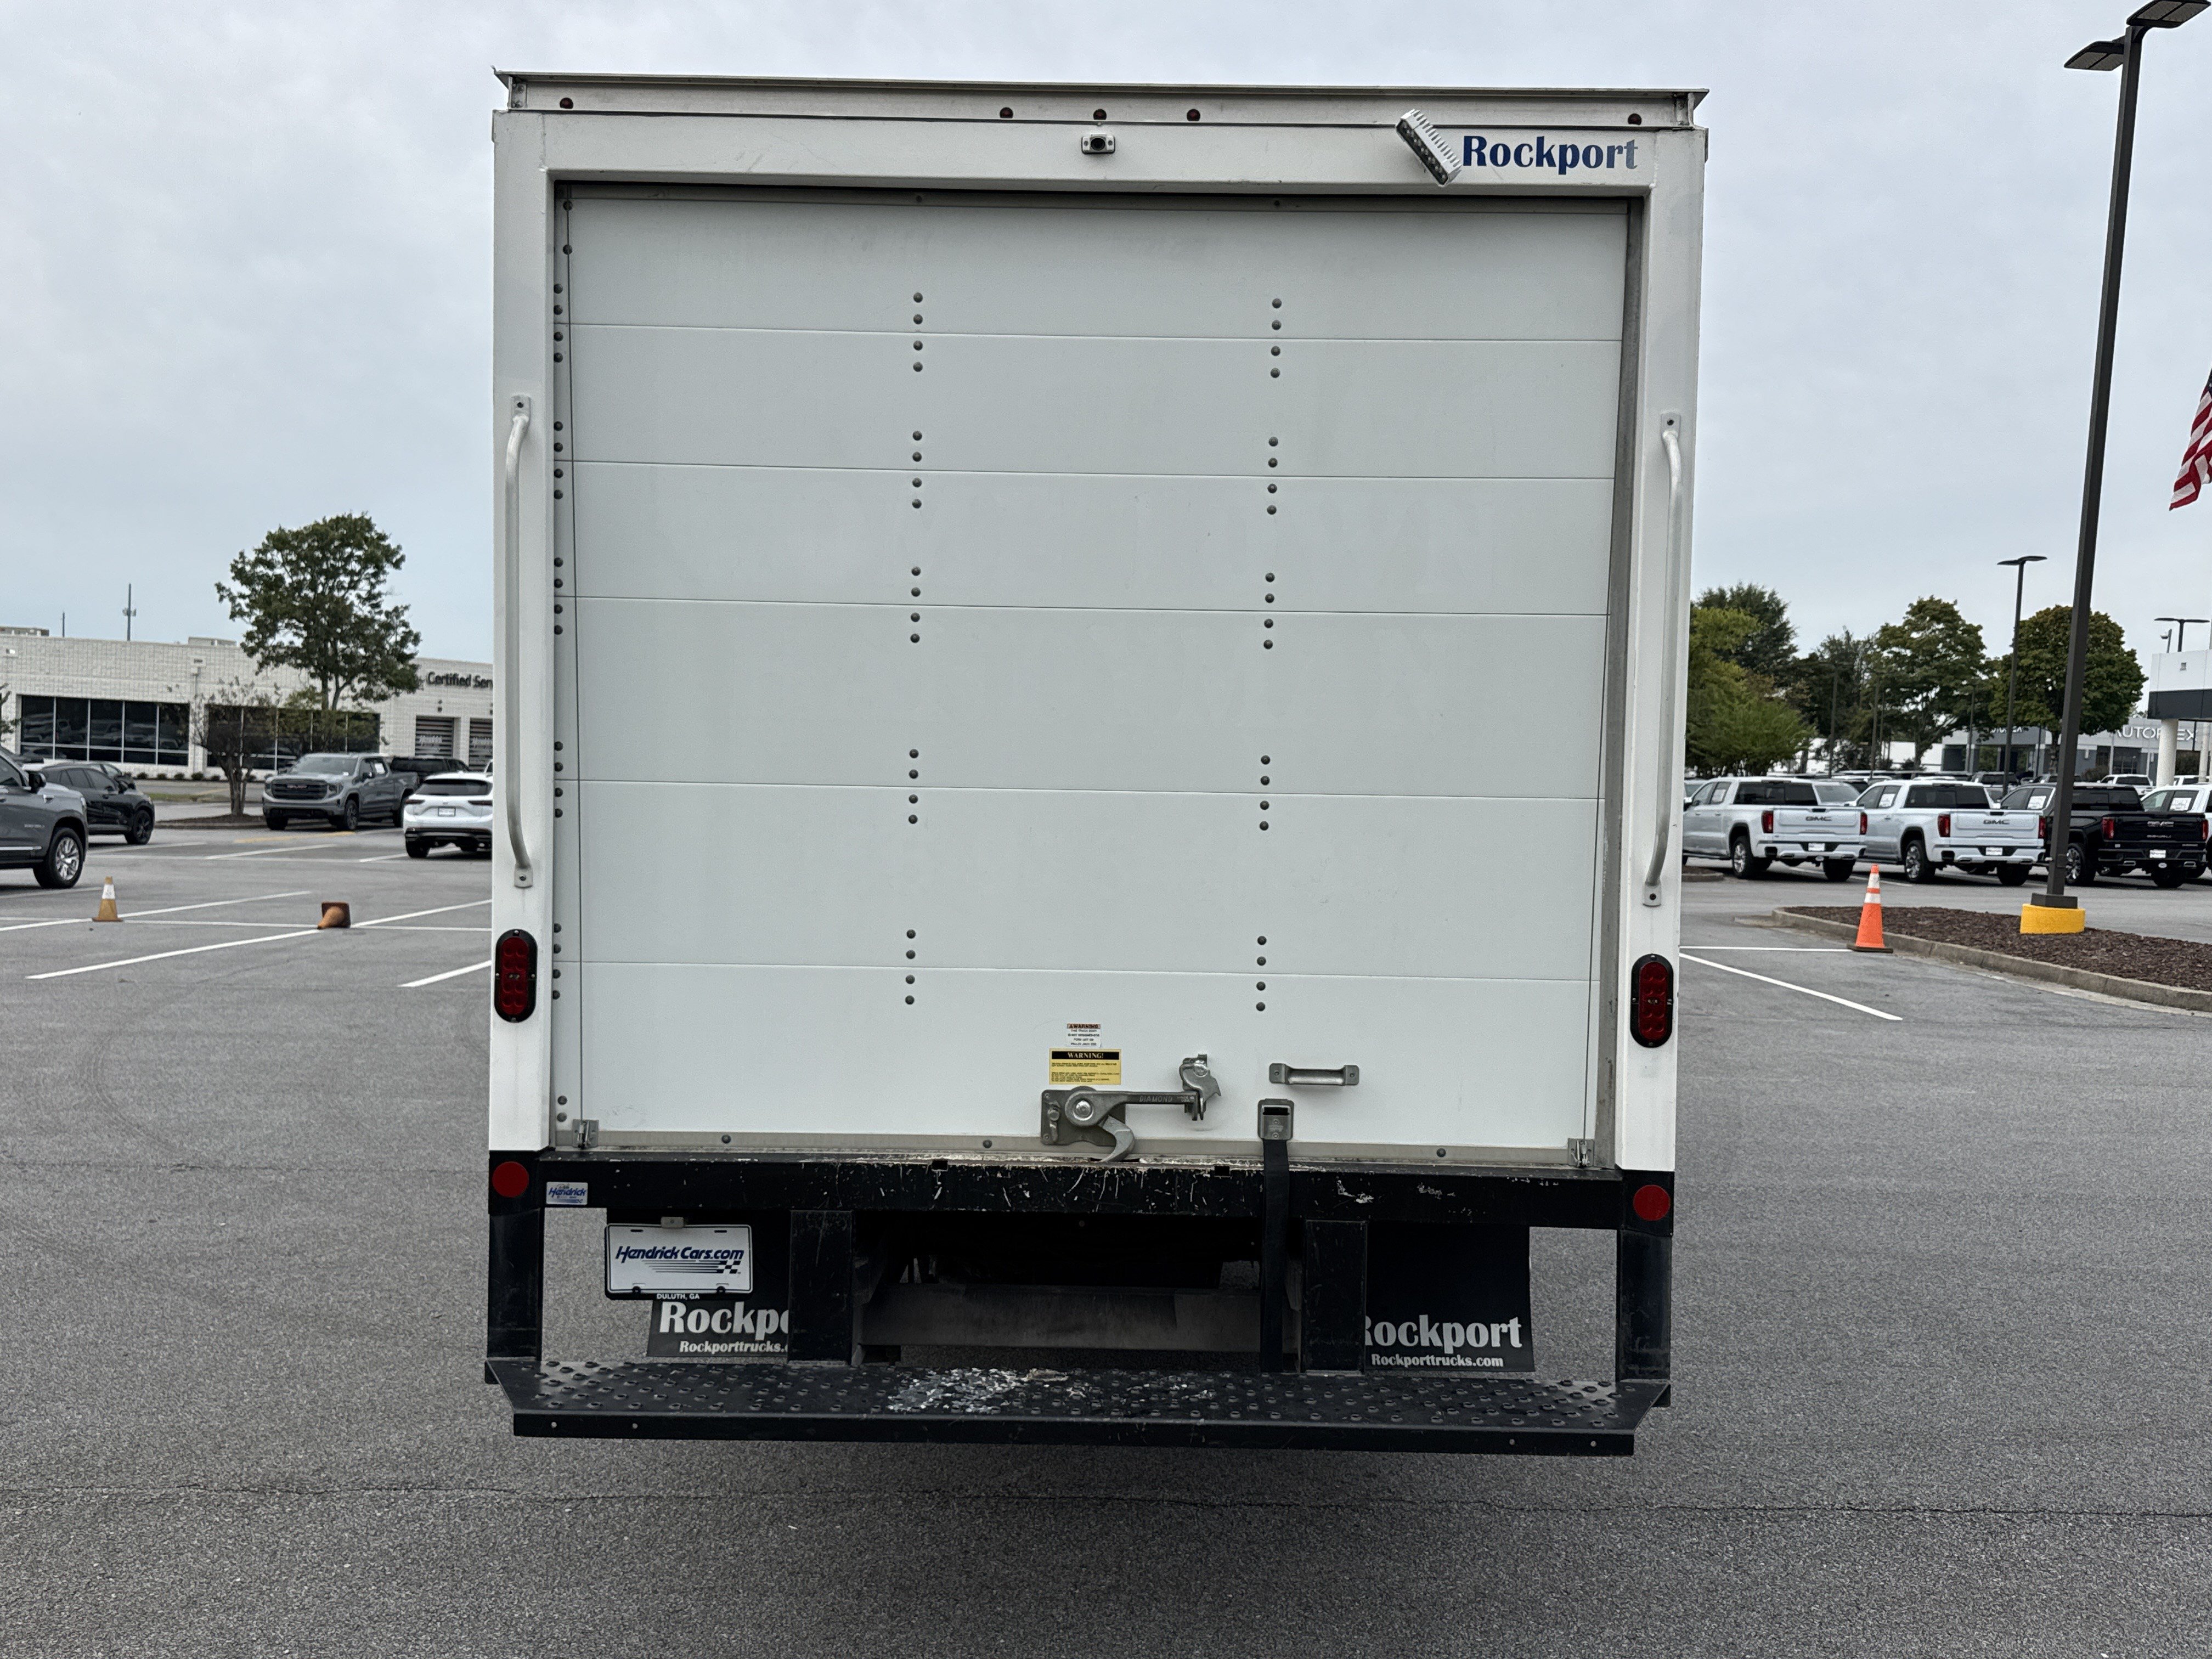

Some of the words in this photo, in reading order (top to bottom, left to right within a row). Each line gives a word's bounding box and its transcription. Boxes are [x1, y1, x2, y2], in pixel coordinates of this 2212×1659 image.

[1463, 136, 1639, 176] Rockport
[427, 672, 471, 686] Certified
[549, 1187, 586, 1198] Hendrick
[1372, 1353, 1504, 1368] Rockporttrucks.com
